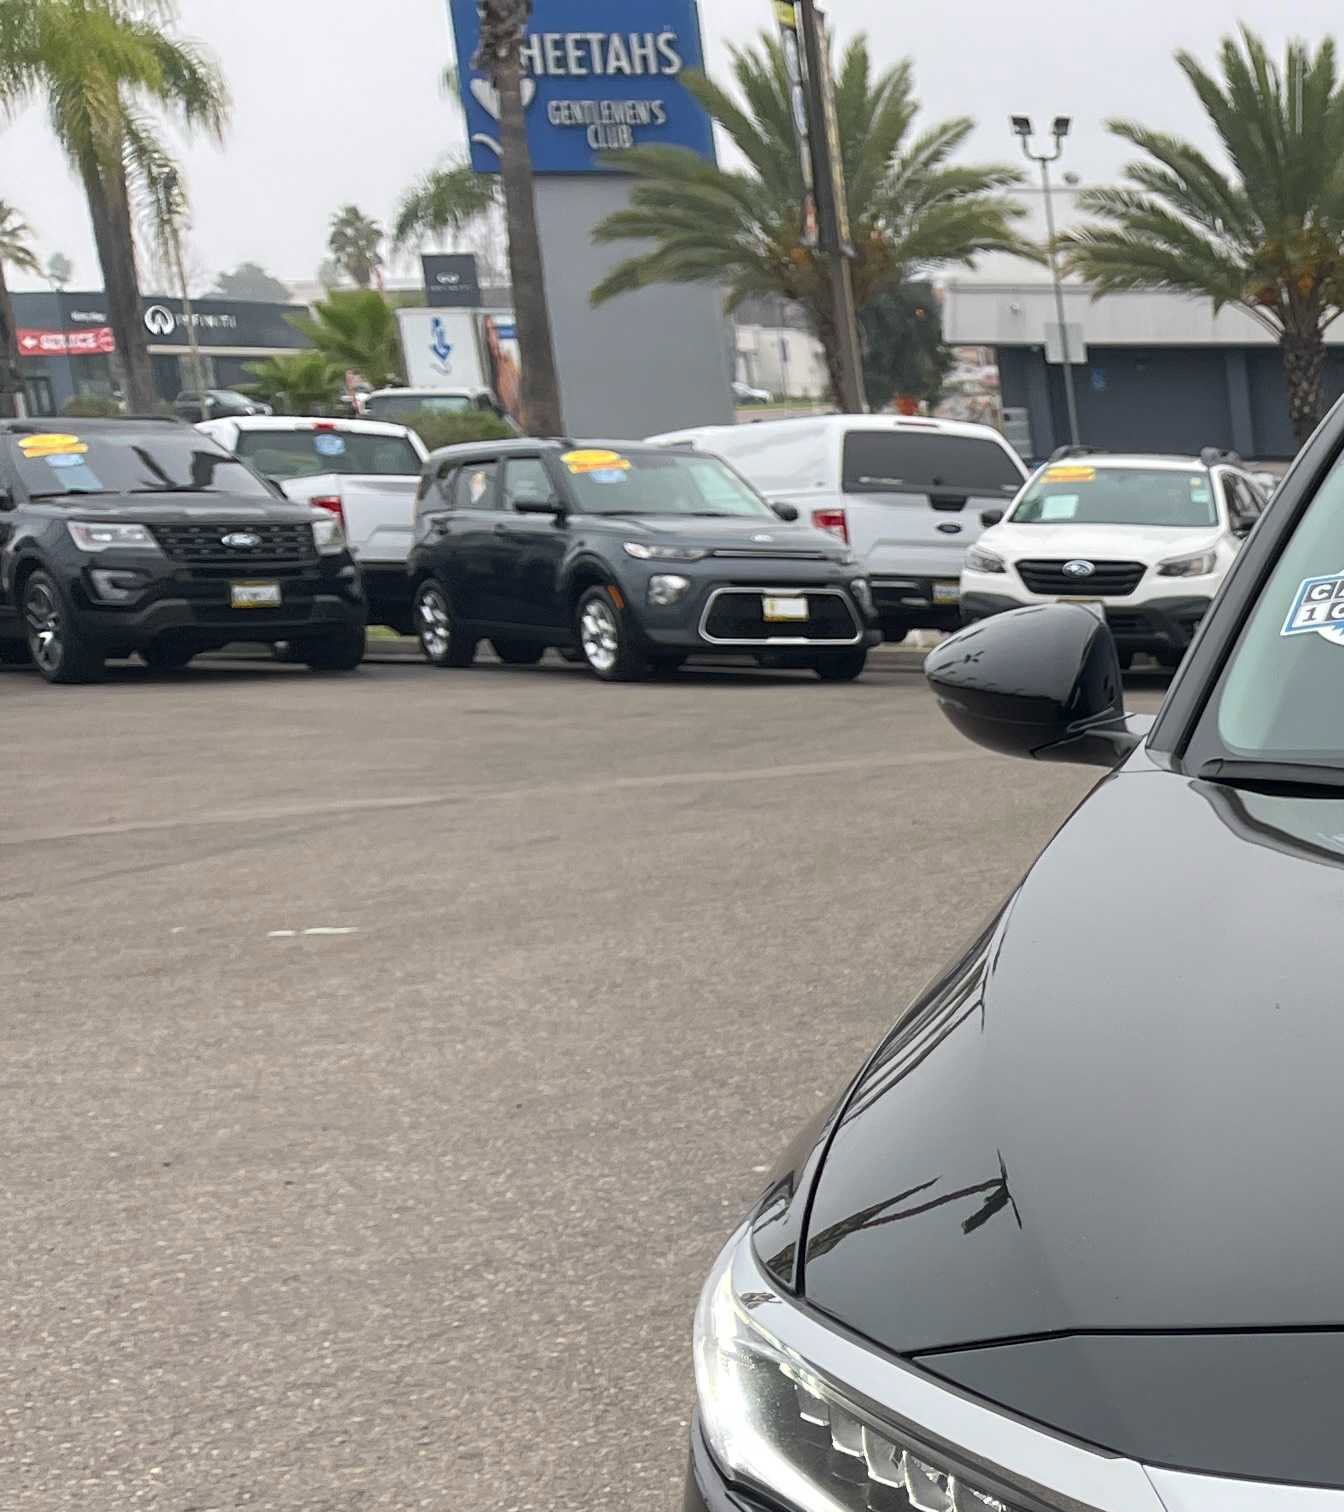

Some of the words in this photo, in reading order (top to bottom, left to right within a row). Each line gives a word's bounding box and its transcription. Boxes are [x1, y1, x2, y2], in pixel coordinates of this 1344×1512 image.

[520, 31, 683, 76] HEETAHS
[548, 100, 668, 125] GENTLEMEN'S
[586, 125, 634, 149] CLUB
[1302, 606, 1317, 622] 1
